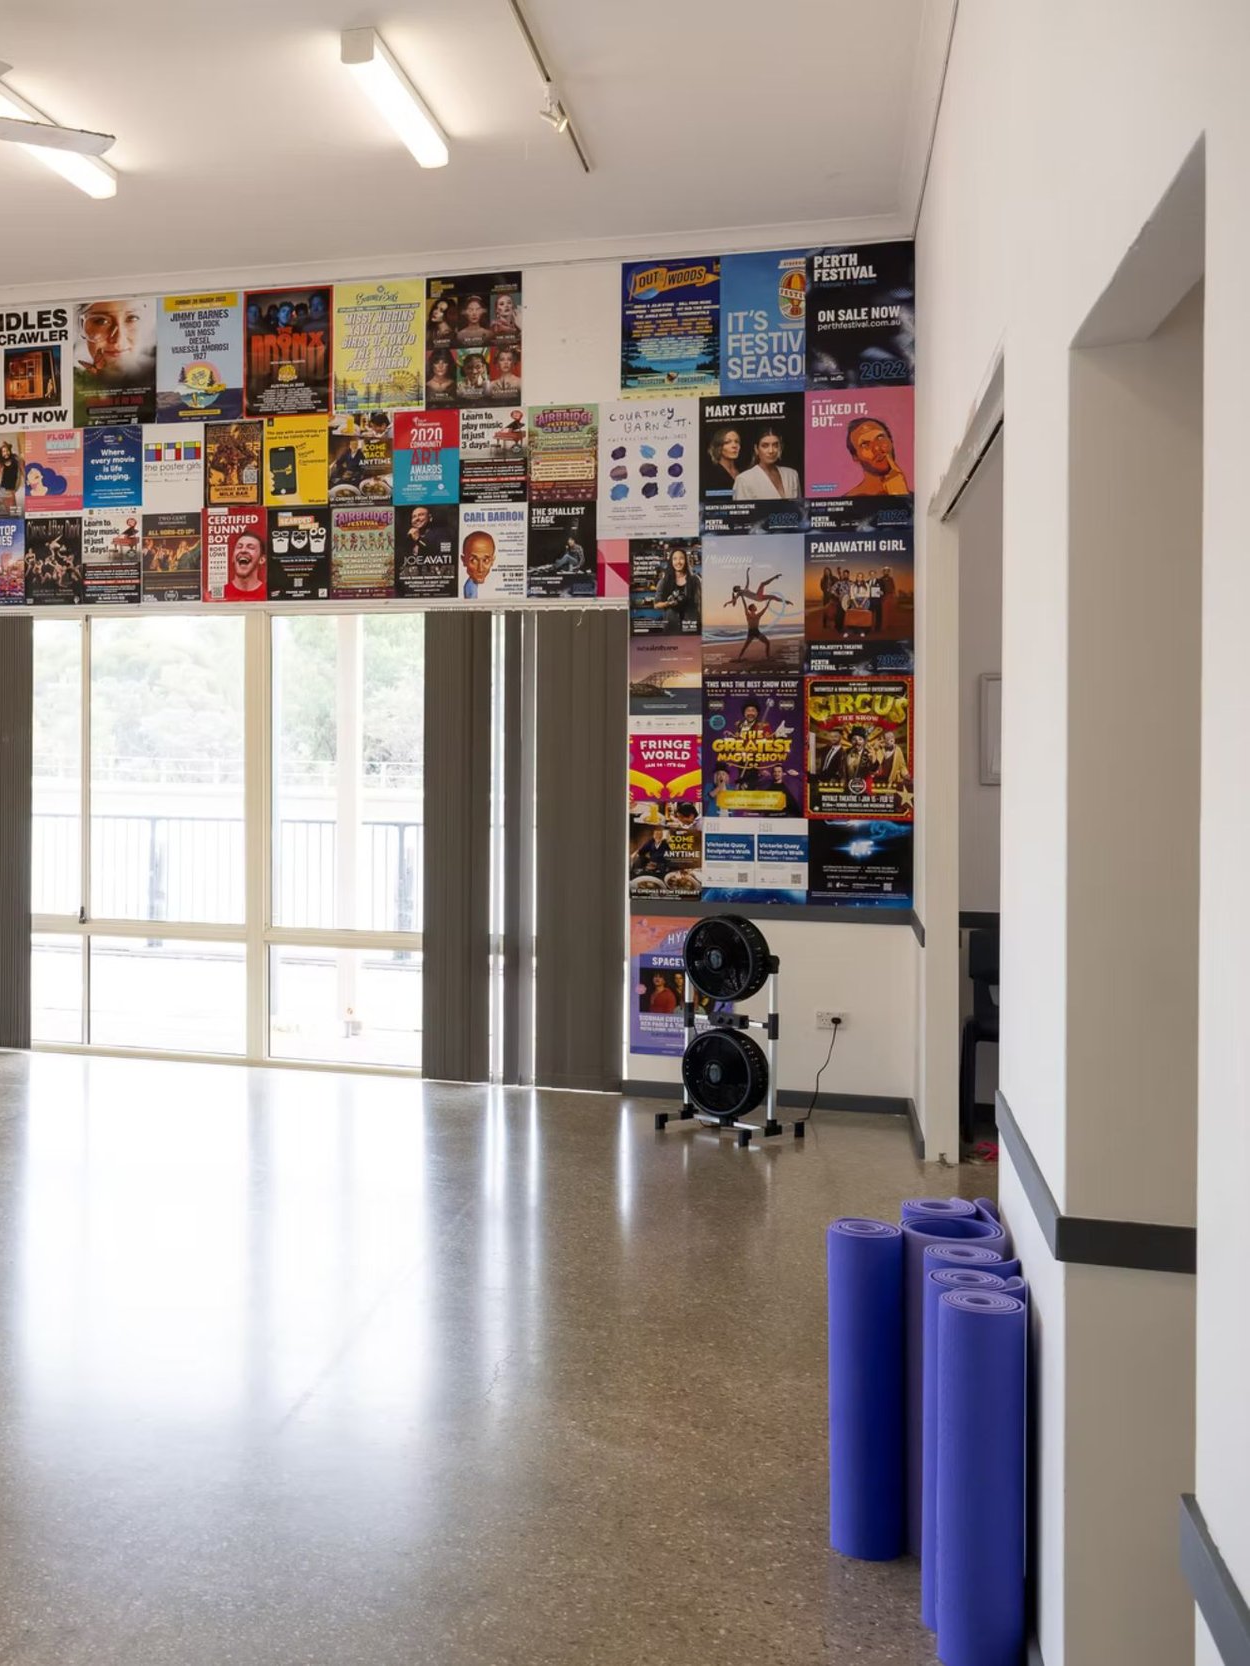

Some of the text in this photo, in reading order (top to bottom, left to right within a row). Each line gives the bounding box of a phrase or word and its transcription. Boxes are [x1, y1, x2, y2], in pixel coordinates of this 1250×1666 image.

[814, 254, 858, 268] PERTH
[639, 268, 703, 287] OUT WOODS
[814, 265, 877, 281] FESTIVAL
[170, 309, 229, 322] JIMMY BARNES
[345, 310, 415, 325] MISSY HIGGINS
[818, 306, 900, 322] ON SALE NOW
[727, 310, 768, 332] IT'S
[818, 319, 900, 331] perthfestival.com.au
[342, 334, 415, 349] BIRDS OF TOKYO
[172, 346, 199, 354] VANESSA
[354, 349, 372, 359] THE
[348, 358, 411, 371] PETE MURRAY
[861, 360, 906, 380] 2022
[610, 408, 674, 421] COURTNEY
[705, 402, 785, 417] MARY STUART
[812, 403, 868, 416] I LIKED IT,
[32, 410, 68, 423] NOW
[535, 412, 592, 424] FAIRBRIDGE
[812, 417, 843, 427] BUT...
[462, 423, 478, 431] play
[411, 428, 442, 441] 2020
[470, 441, 490, 449] days!
[411, 449, 440, 464] ART
[160, 463, 185, 471] poster
[187, 462, 201, 471] girls
[410, 465, 442, 474] AWARDS
[464, 511, 523, 522] CARL BARRON
[548, 507, 585, 515] SMALLEST
[208, 515, 258, 525] CERTIFIED
[334, 511, 394, 531] FAIRBRIDGE
[208, 525, 246, 534] FUNNY
[208, 535, 229, 543] BOY
[811, 540, 905, 553] PANAWATHI GIRL
[809, 694, 908, 723] CIRCUS
[742, 731, 763, 739] THE
[640, 740, 691, 749] FRINGE
[712, 739, 792, 752] GREATEST
[642, 751, 690, 760] WORLD
[718, 753, 788, 761] MAGIC SHOW
